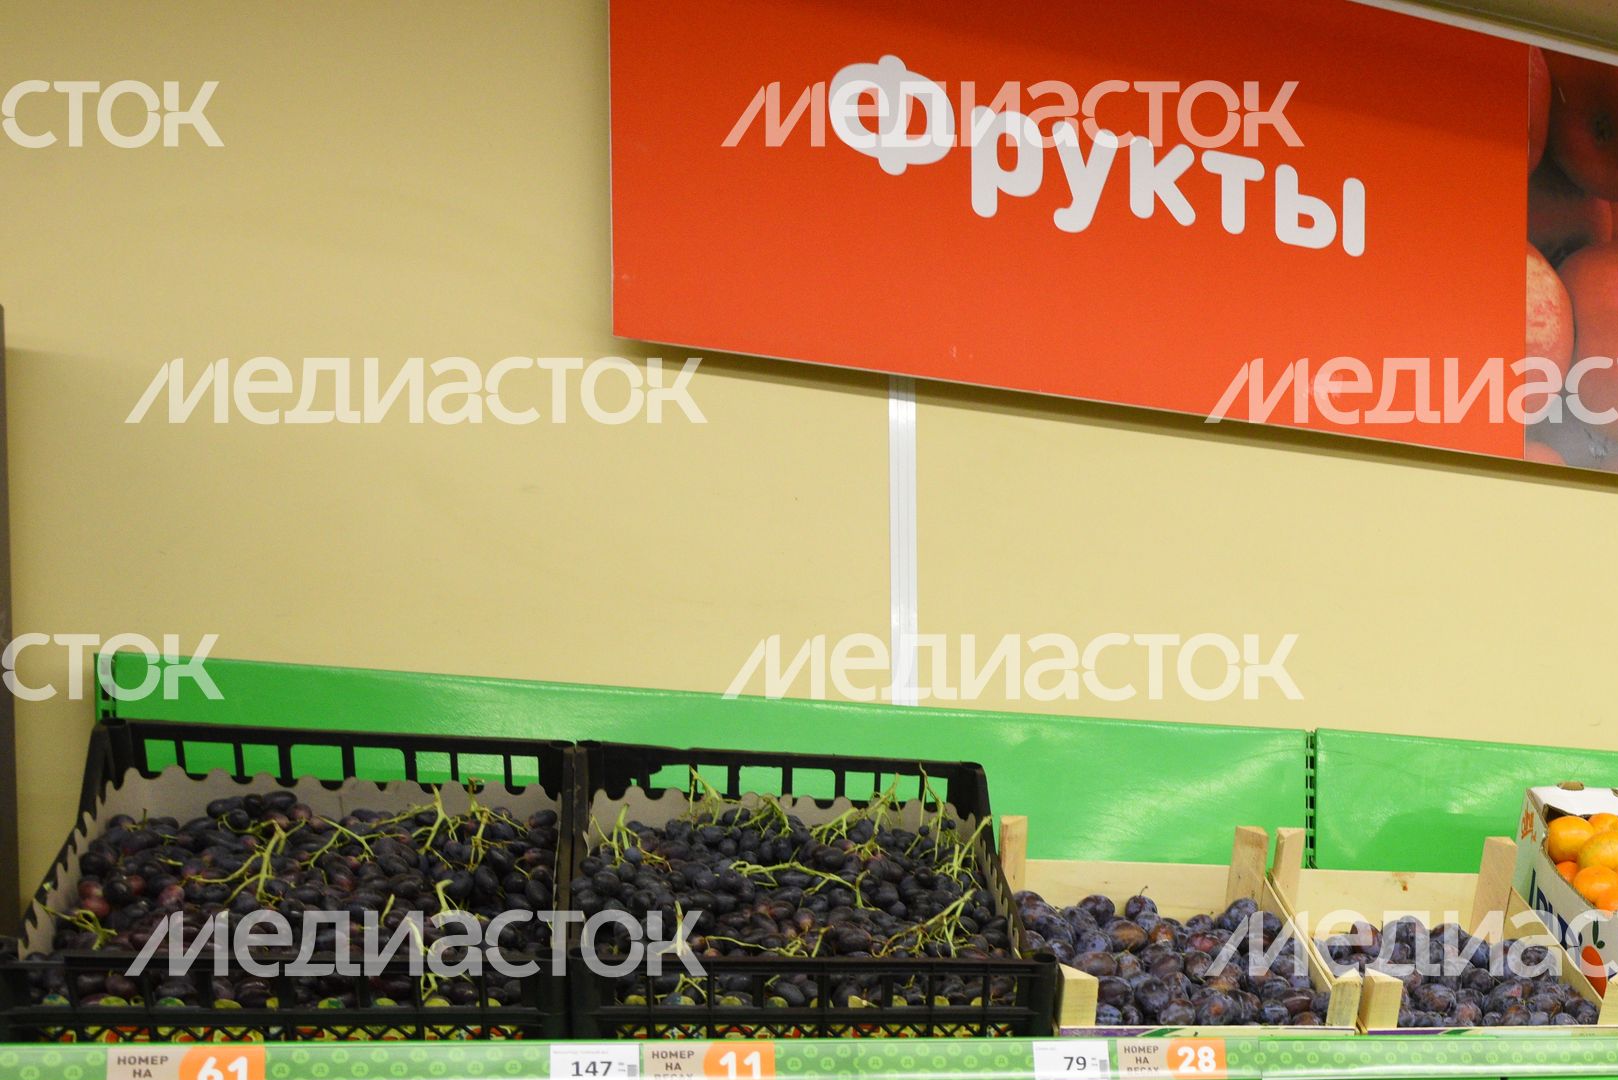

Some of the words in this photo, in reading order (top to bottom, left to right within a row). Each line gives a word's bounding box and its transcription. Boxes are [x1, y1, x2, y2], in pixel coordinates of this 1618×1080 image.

[829, 55, 1365, 257] Фрукты
[651, 1050, 695, 1060] НОМЕР
[1124, 1045, 1159, 1054] НОМЕР
[117, 1055, 169, 1065] НОМЕР
[719, 1050, 762, 1080] 11
[1063, 1056, 1087, 1071] 79
[1177, 1046, 1217, 1074] 28
[571, 1061, 613, 1077] 147
[665, 1063, 682, 1071] НА
[133, 1069, 153, 1078] НА
